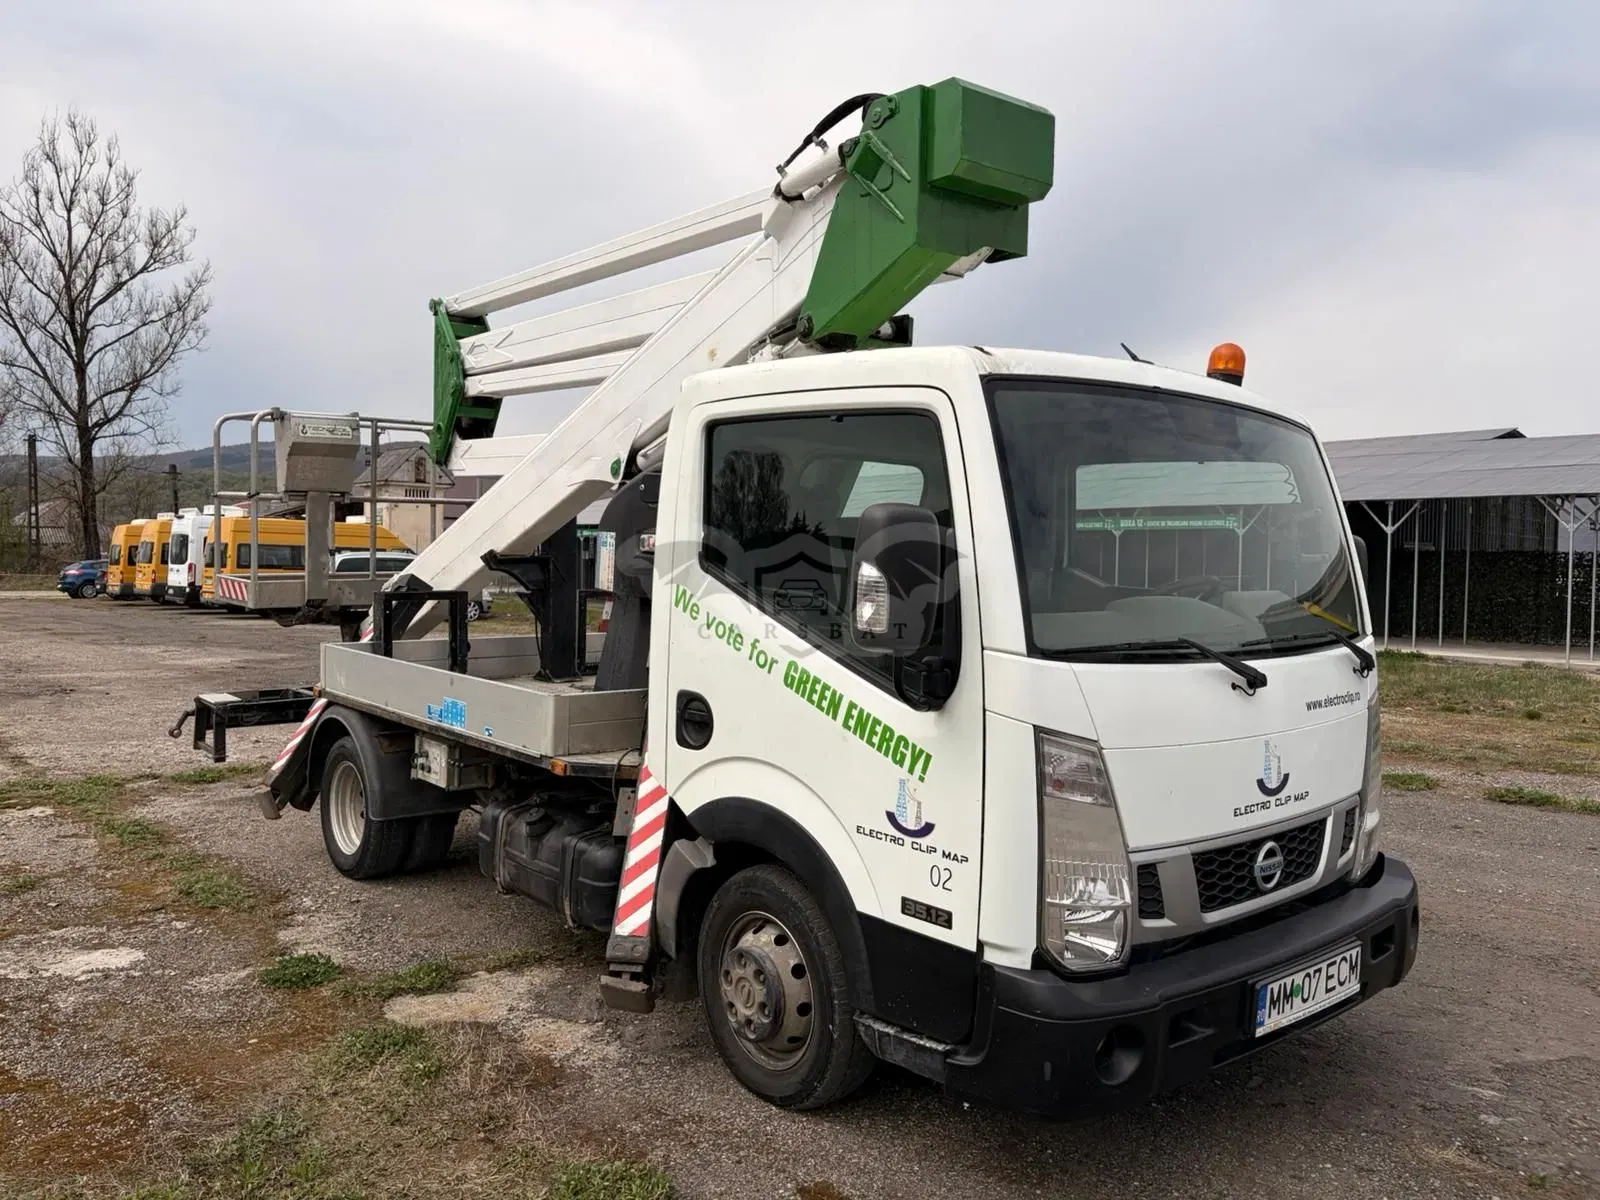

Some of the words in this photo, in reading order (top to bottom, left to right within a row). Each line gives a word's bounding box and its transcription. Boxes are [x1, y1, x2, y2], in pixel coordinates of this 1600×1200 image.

[674, 584, 700, 620] We
[705, 611, 744, 652] vote
[748, 638, 778, 674] for
[783, 660, 844, 721] GREEN
[841, 700, 933, 783] ENERGY!
[1306, 691, 1360, 711] www.electroclip.ro
[1233, 800, 1271, 817] ELECTRO
[1274, 795, 1292, 807] CLIP
[1294, 791, 1310, 802] MAP
[856, 825, 905, 846] ELECTRO
[911, 841, 937, 854] CLIP
[942, 850, 969, 864] MAP
[930, 865, 952, 891] 02
[1260, 859, 1283, 874] NISSAN
[904, 900, 949, 926] 35.12
[1268, 979, 1295, 1018] MM
[1301, 967, 1322, 1004] 07
[1325, 950, 1360, 994] ECM
